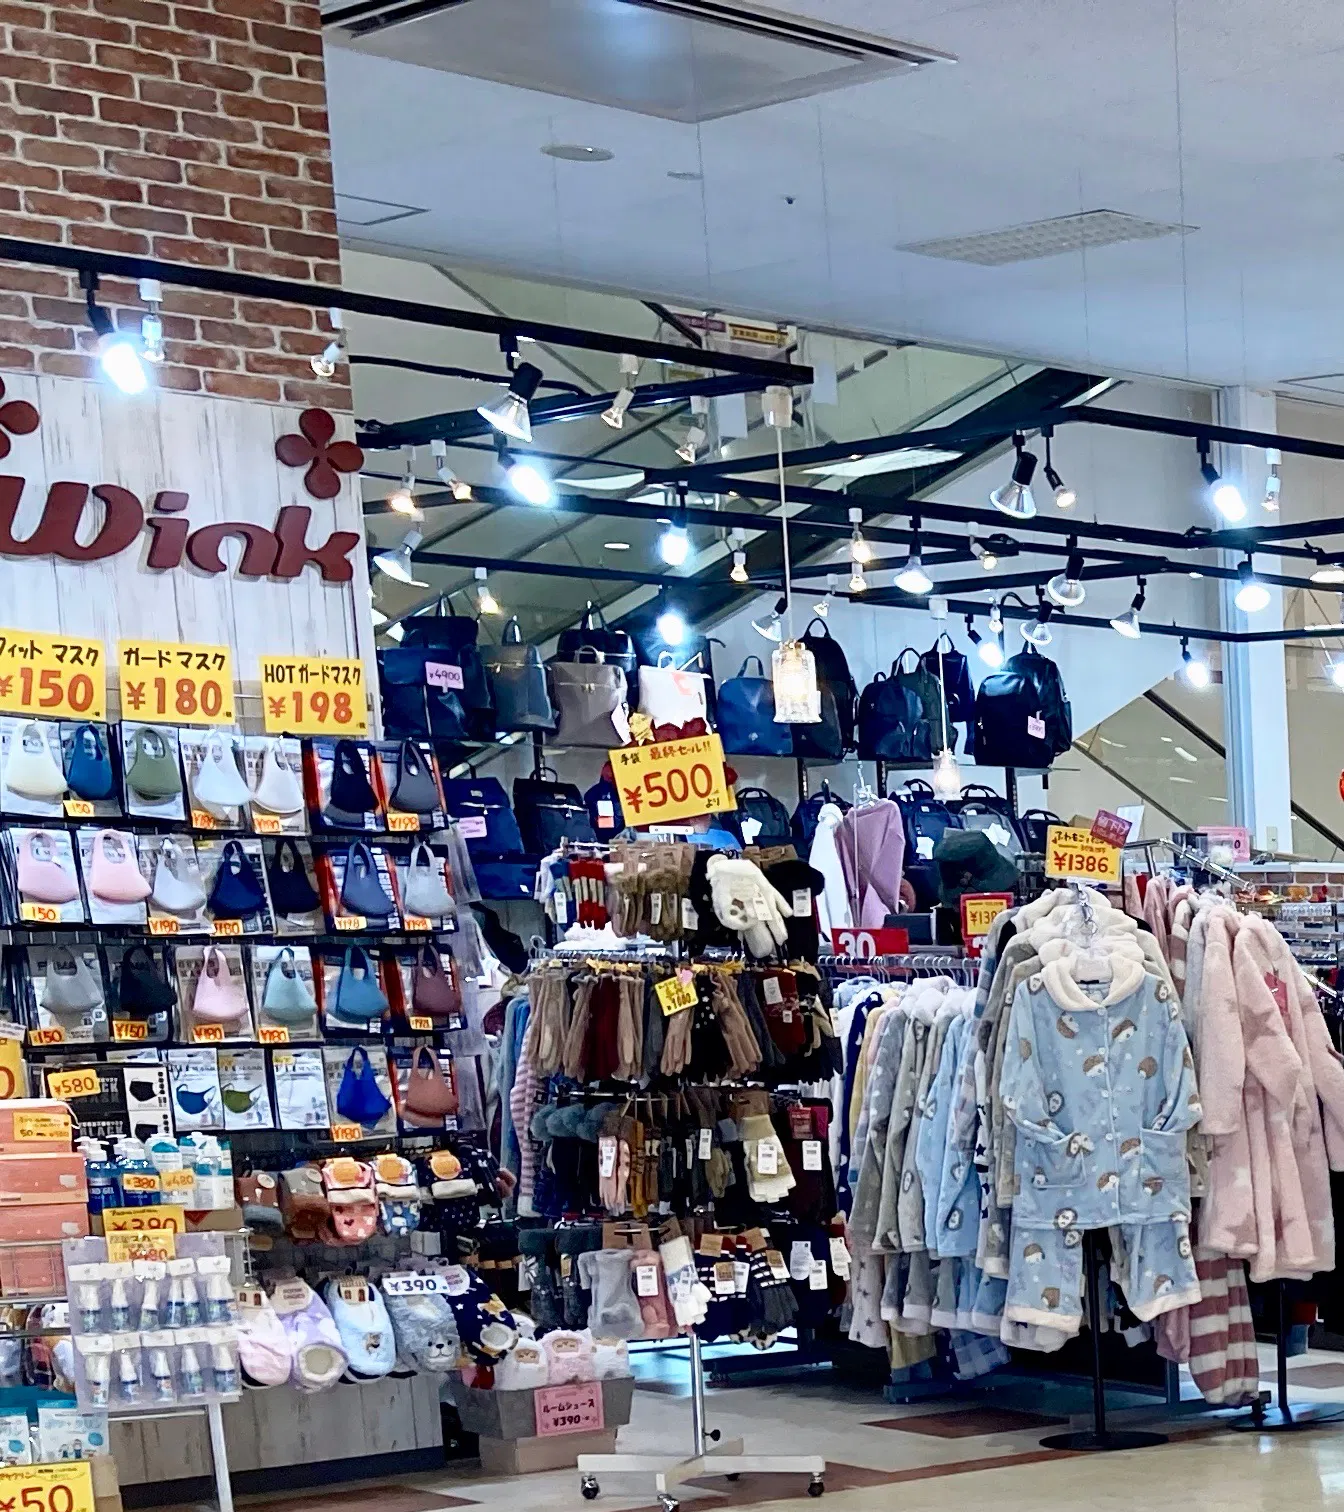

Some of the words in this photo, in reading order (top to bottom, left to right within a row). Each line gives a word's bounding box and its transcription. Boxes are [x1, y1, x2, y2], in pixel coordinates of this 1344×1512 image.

[0, 475, 360, 582] Wink
[52, 644, 99, 667] マスク
[124, 647, 171, 668] ガード
[177, 651, 226, 671] マスク
[264, 663, 296, 684] HOT
[0, 666, 94, 712] ¥150
[126, 677, 223, 717] ¥180
[267, 691, 353, 724] ¥198
[623, 763, 713, 814] ¥500
[1053, 850, 1109, 873] ¥1386
[968, 910, 997, 926] ¥138
[54, 1076, 95, 1094] ¥580
[388, 1279, 438, 1293] ¥390
